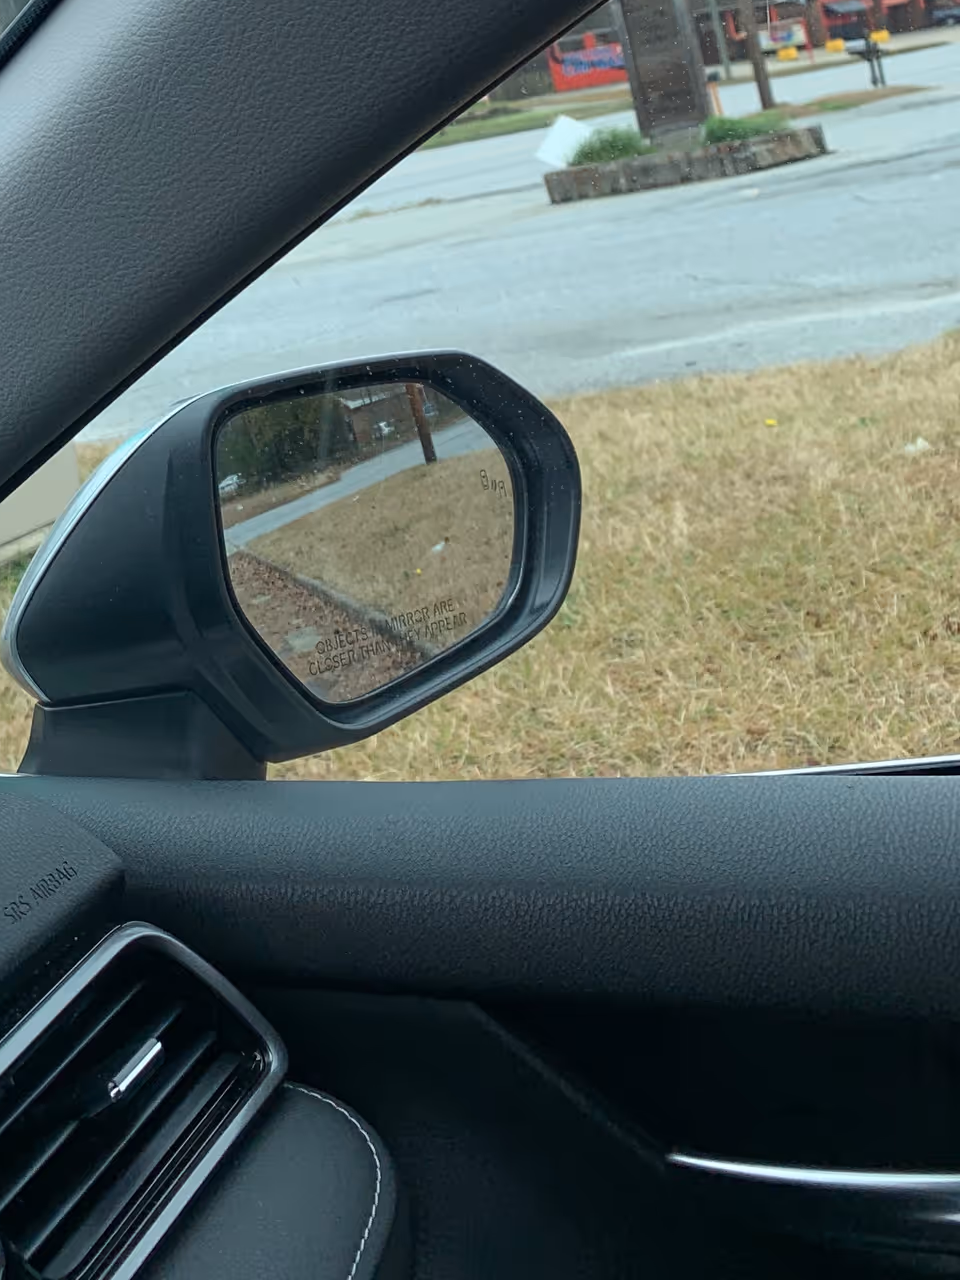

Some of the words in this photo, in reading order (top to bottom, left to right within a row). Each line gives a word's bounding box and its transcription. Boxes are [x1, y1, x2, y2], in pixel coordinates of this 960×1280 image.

[308, 649, 356, 676] CLOSER
[359, 639, 392, 661] THAN
[424, 612, 468, 639] APPEAR
[315, 627, 369, 655] OBJECTS
[385, 606, 430, 633] MIRROR
[433, 598, 456, 618] ARE
[3, 895, 32, 925] SRS
[30, 860, 78, 906] AIRBAG
